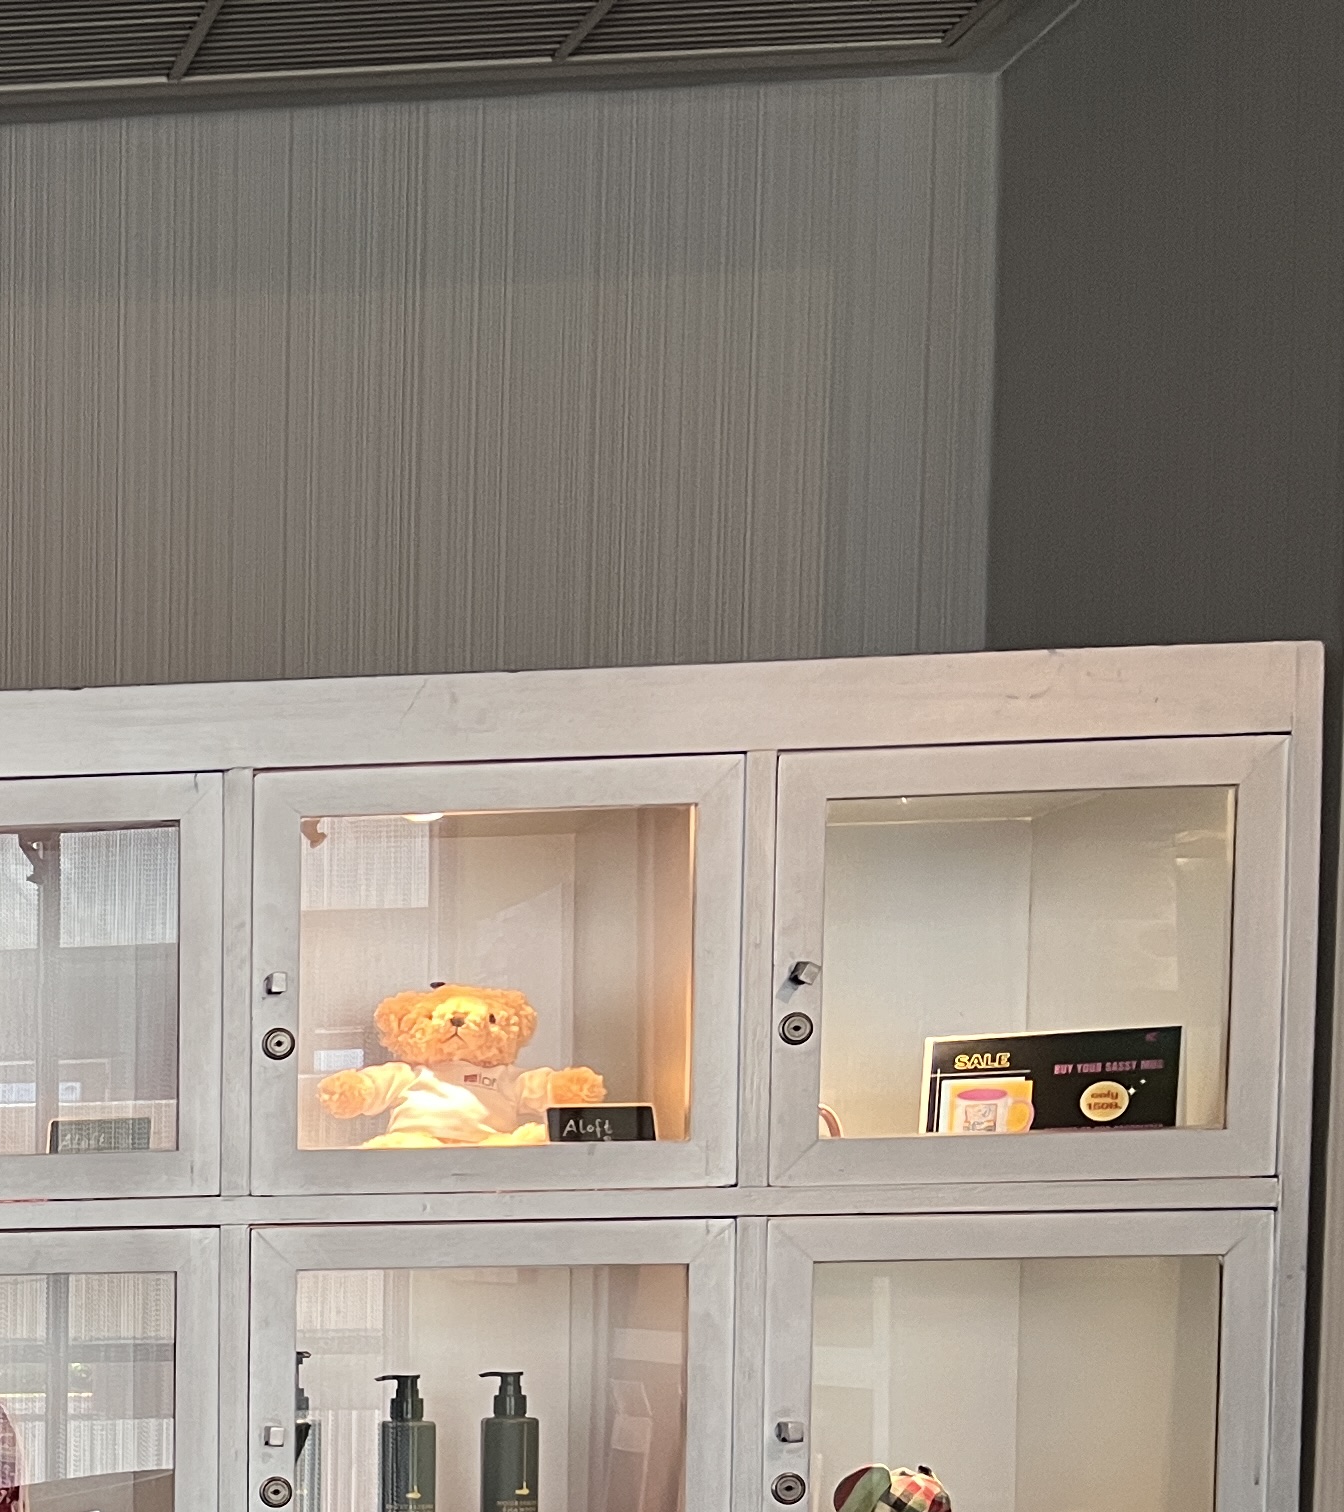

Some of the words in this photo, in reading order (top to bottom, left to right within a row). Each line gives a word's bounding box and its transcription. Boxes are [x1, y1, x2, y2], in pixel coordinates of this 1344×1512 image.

[953, 1052, 1011, 1069] SALE
[1053, 1064, 1073, 1075] BUY
[1076, 1062, 1103, 1073] YOUR
[1105, 1060, 1138, 1072] SASSY
[562, 1118, 613, 1139] Aloft
